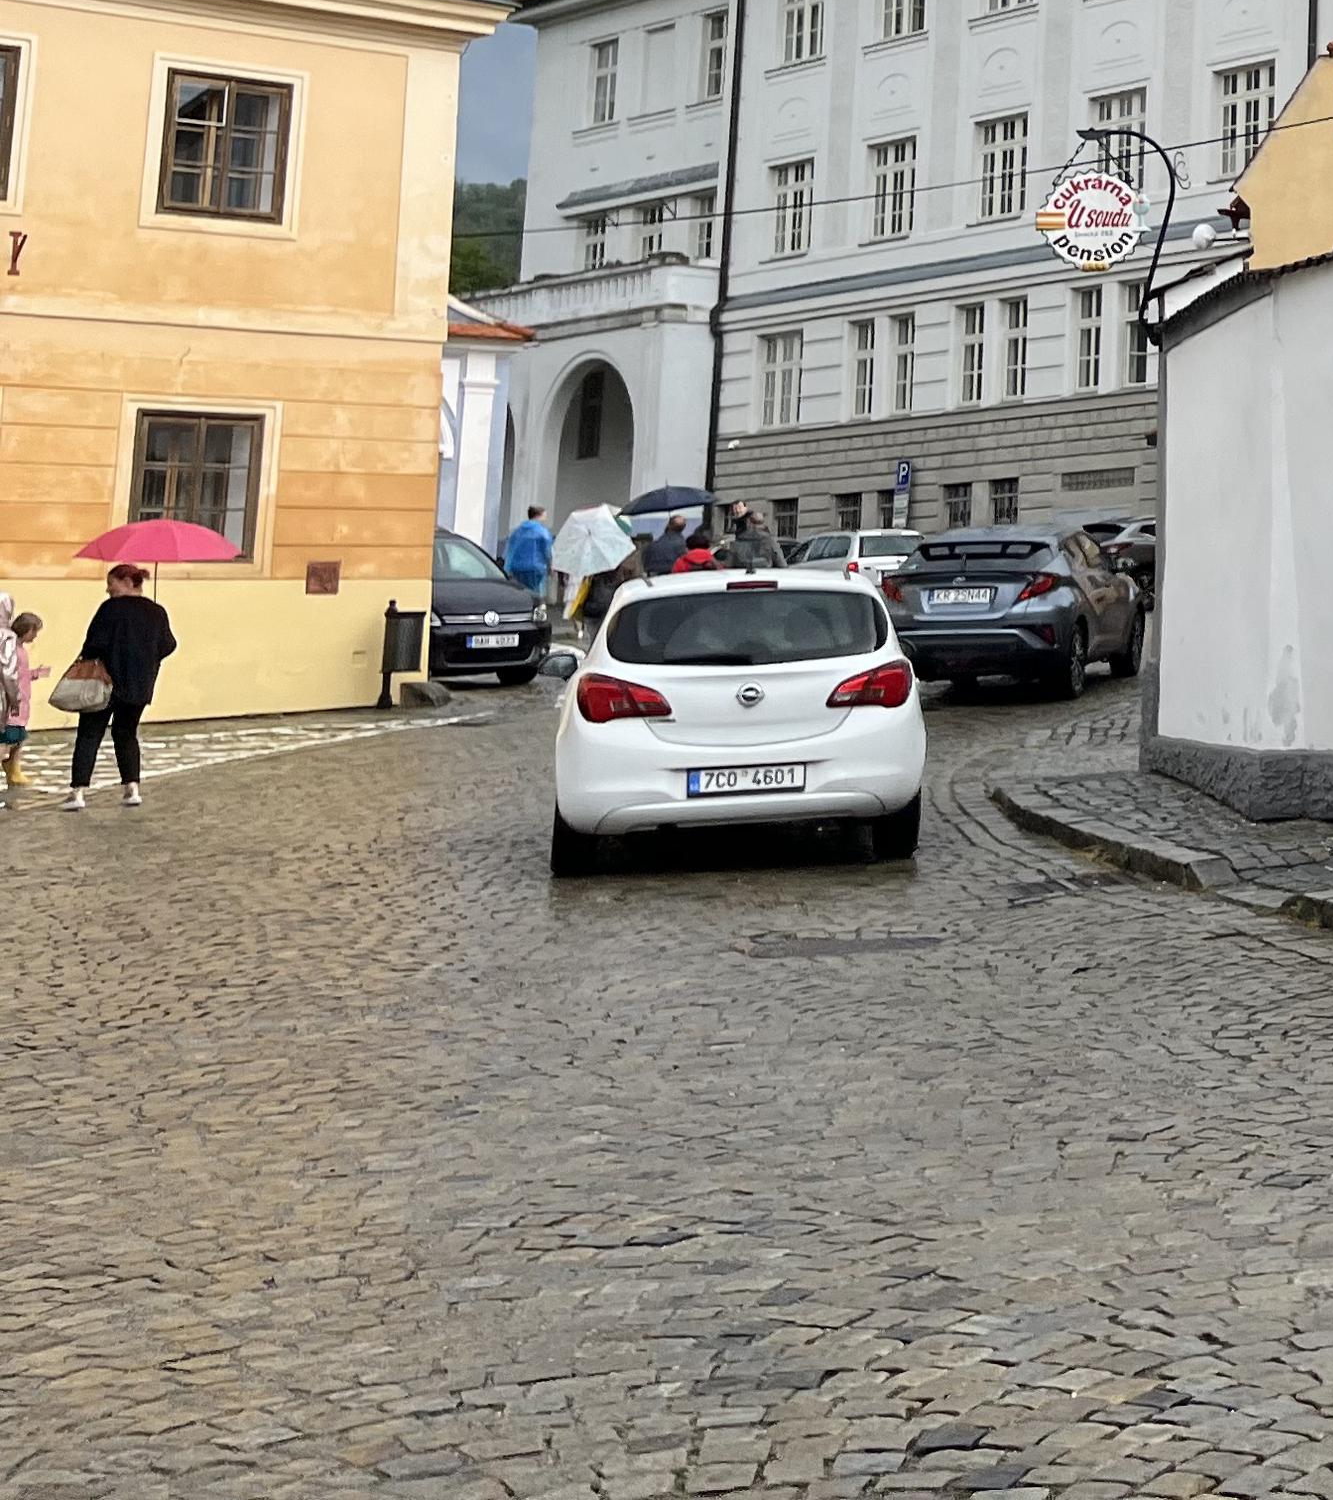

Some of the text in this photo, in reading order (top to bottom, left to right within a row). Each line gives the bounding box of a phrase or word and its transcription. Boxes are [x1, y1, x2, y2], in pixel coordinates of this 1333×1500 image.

[1054, 176, 1132, 209] cukrárna
[1067, 199, 1132, 229] U soudu
[1053, 232, 1133, 262] pension
[751, 767, 796, 786] 4601
